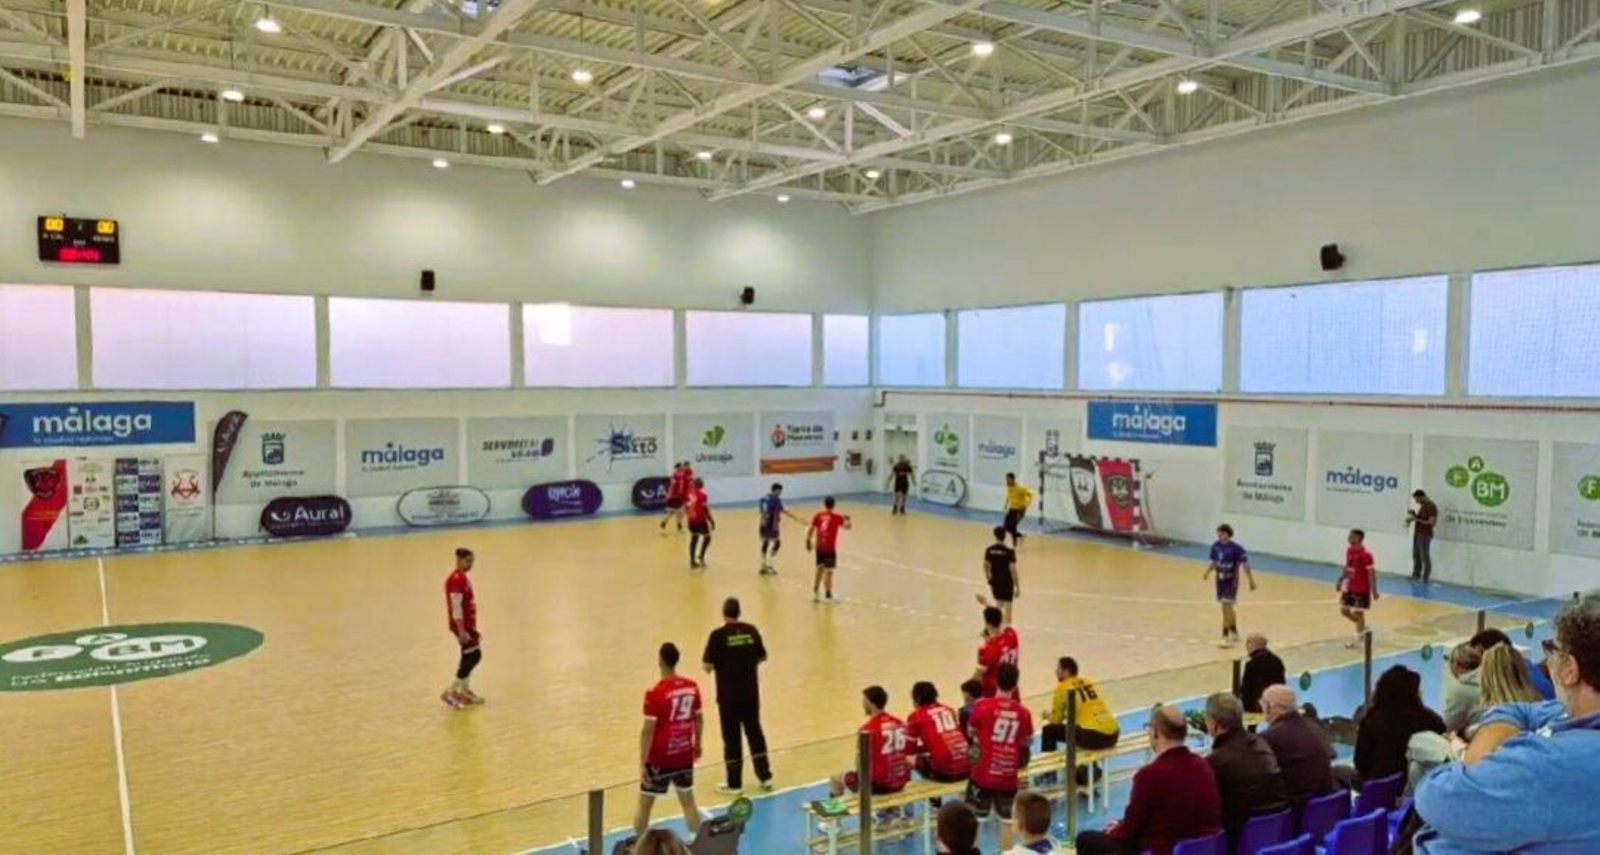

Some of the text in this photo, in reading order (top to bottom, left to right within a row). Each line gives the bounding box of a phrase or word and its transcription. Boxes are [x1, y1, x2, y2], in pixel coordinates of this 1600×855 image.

[33, 406, 152, 438] málaga
[1112, 404, 1186, 435] málaga
[361, 442, 444, 467] málaga
[1326, 466, 1398, 492] málaga
[1477, 481, 1506, 500] BM
[294, 503, 344, 521] Aural
[107, 638, 197, 657] BM
[1076, 685, 1098, 703] 16
[668, 694, 696, 721] 19
[991, 718, 1020, 743] 91
